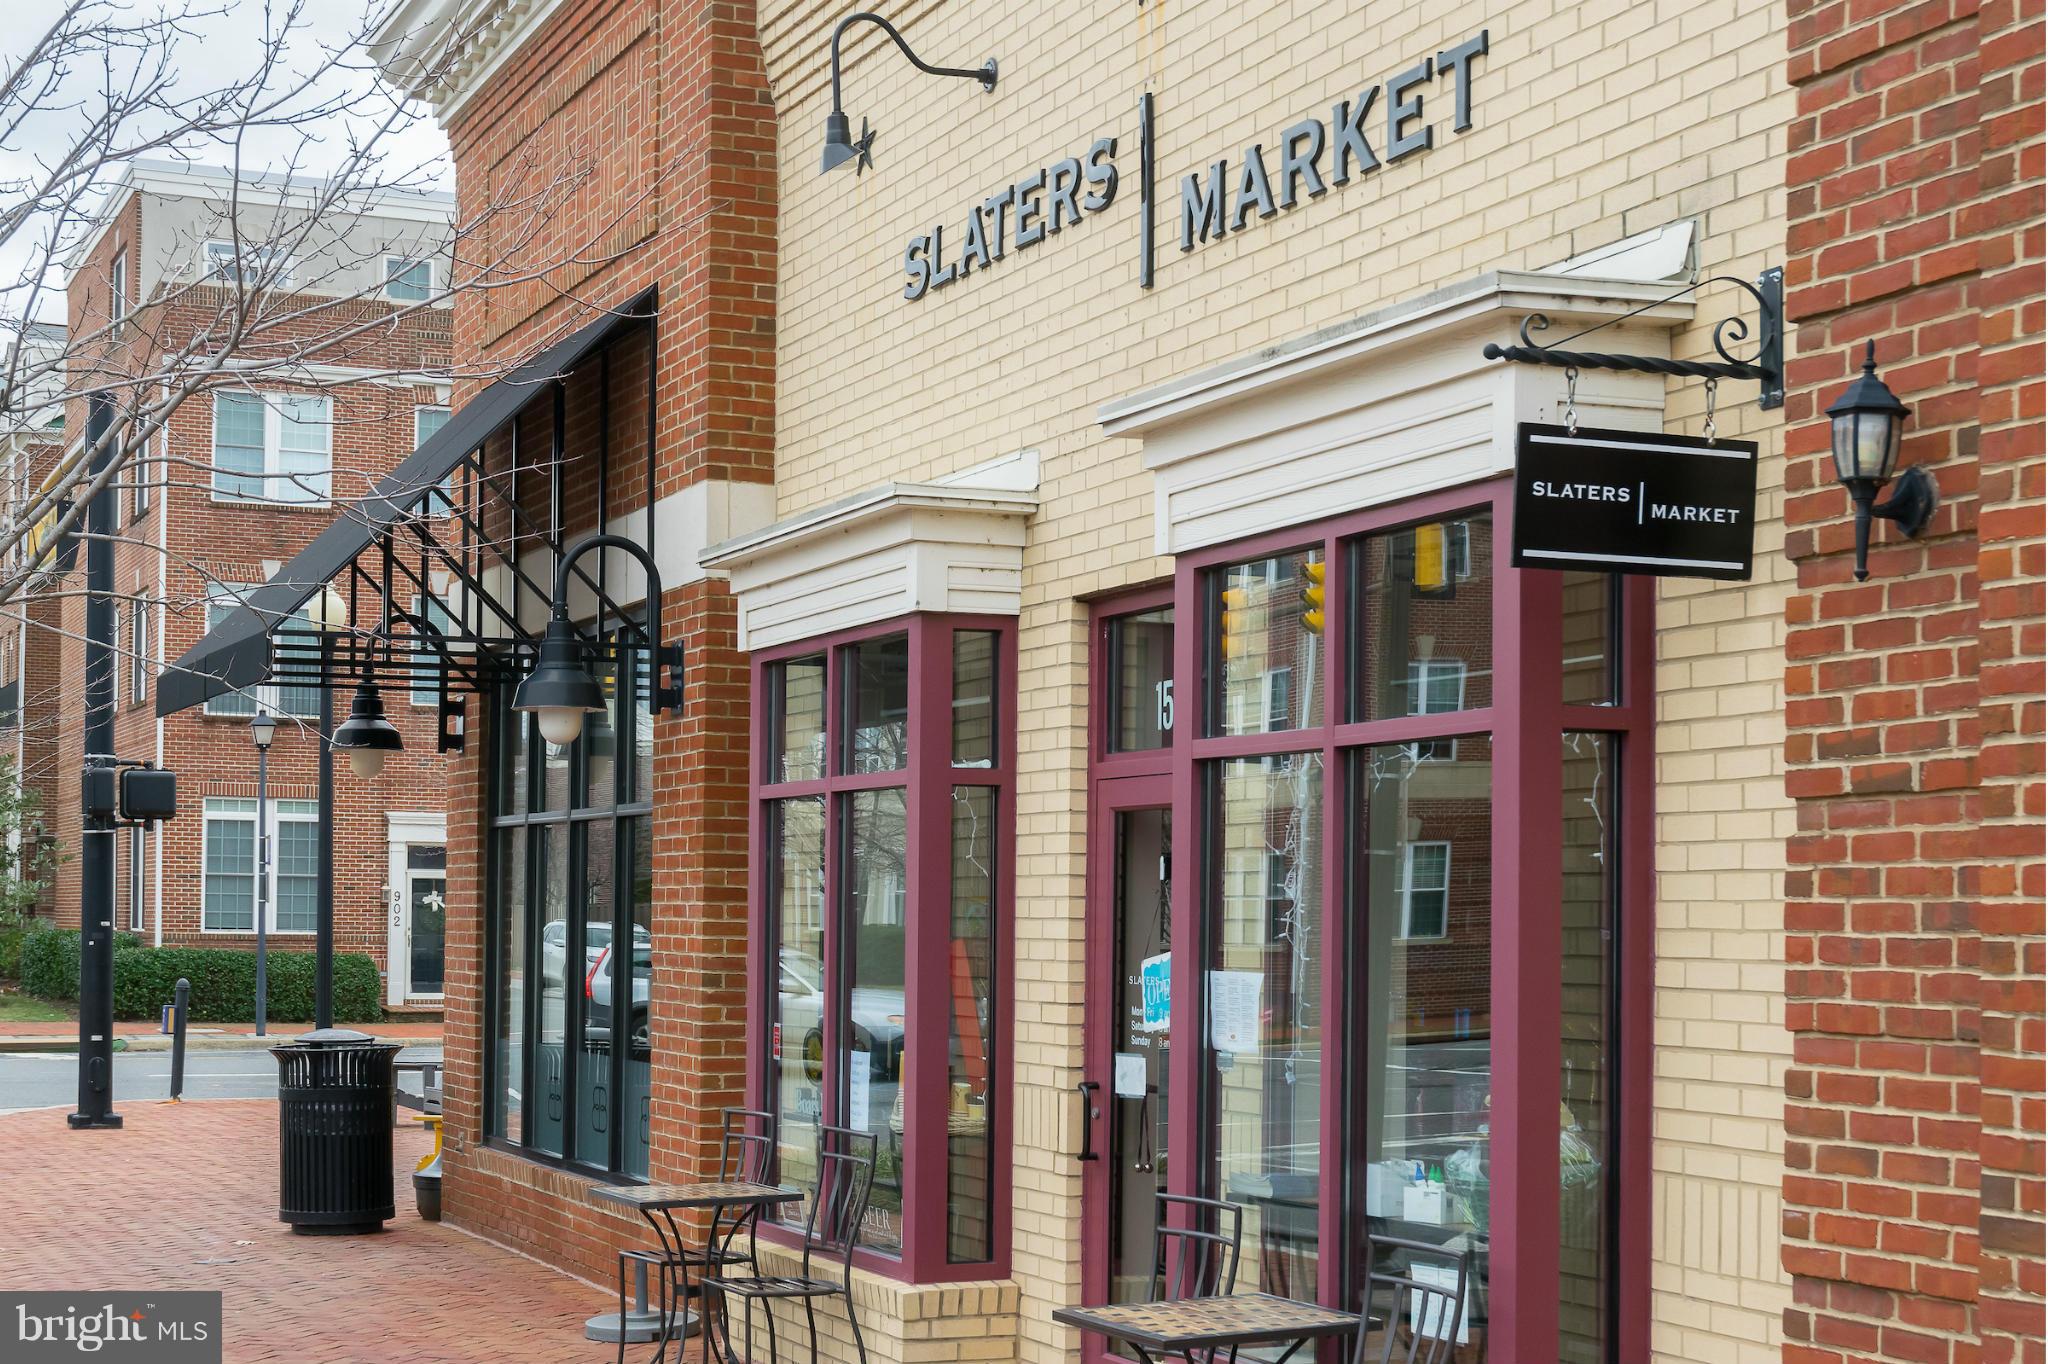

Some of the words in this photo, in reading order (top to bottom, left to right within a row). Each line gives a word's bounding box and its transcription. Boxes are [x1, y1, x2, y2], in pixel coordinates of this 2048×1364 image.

[904, 137, 1118, 300] SLATERS
[1180, 29, 1489, 253] MARKET
[1532, 481, 1631, 502] SLATERS
[1651, 504, 1740, 524] MARKET
[393, 891, 401, 927] 902
[1128, 975, 1160, 985] SLATERS
[1147, 978, 1171, 1006] OPE
[1131, 1035, 1151, 1048] Sunday
